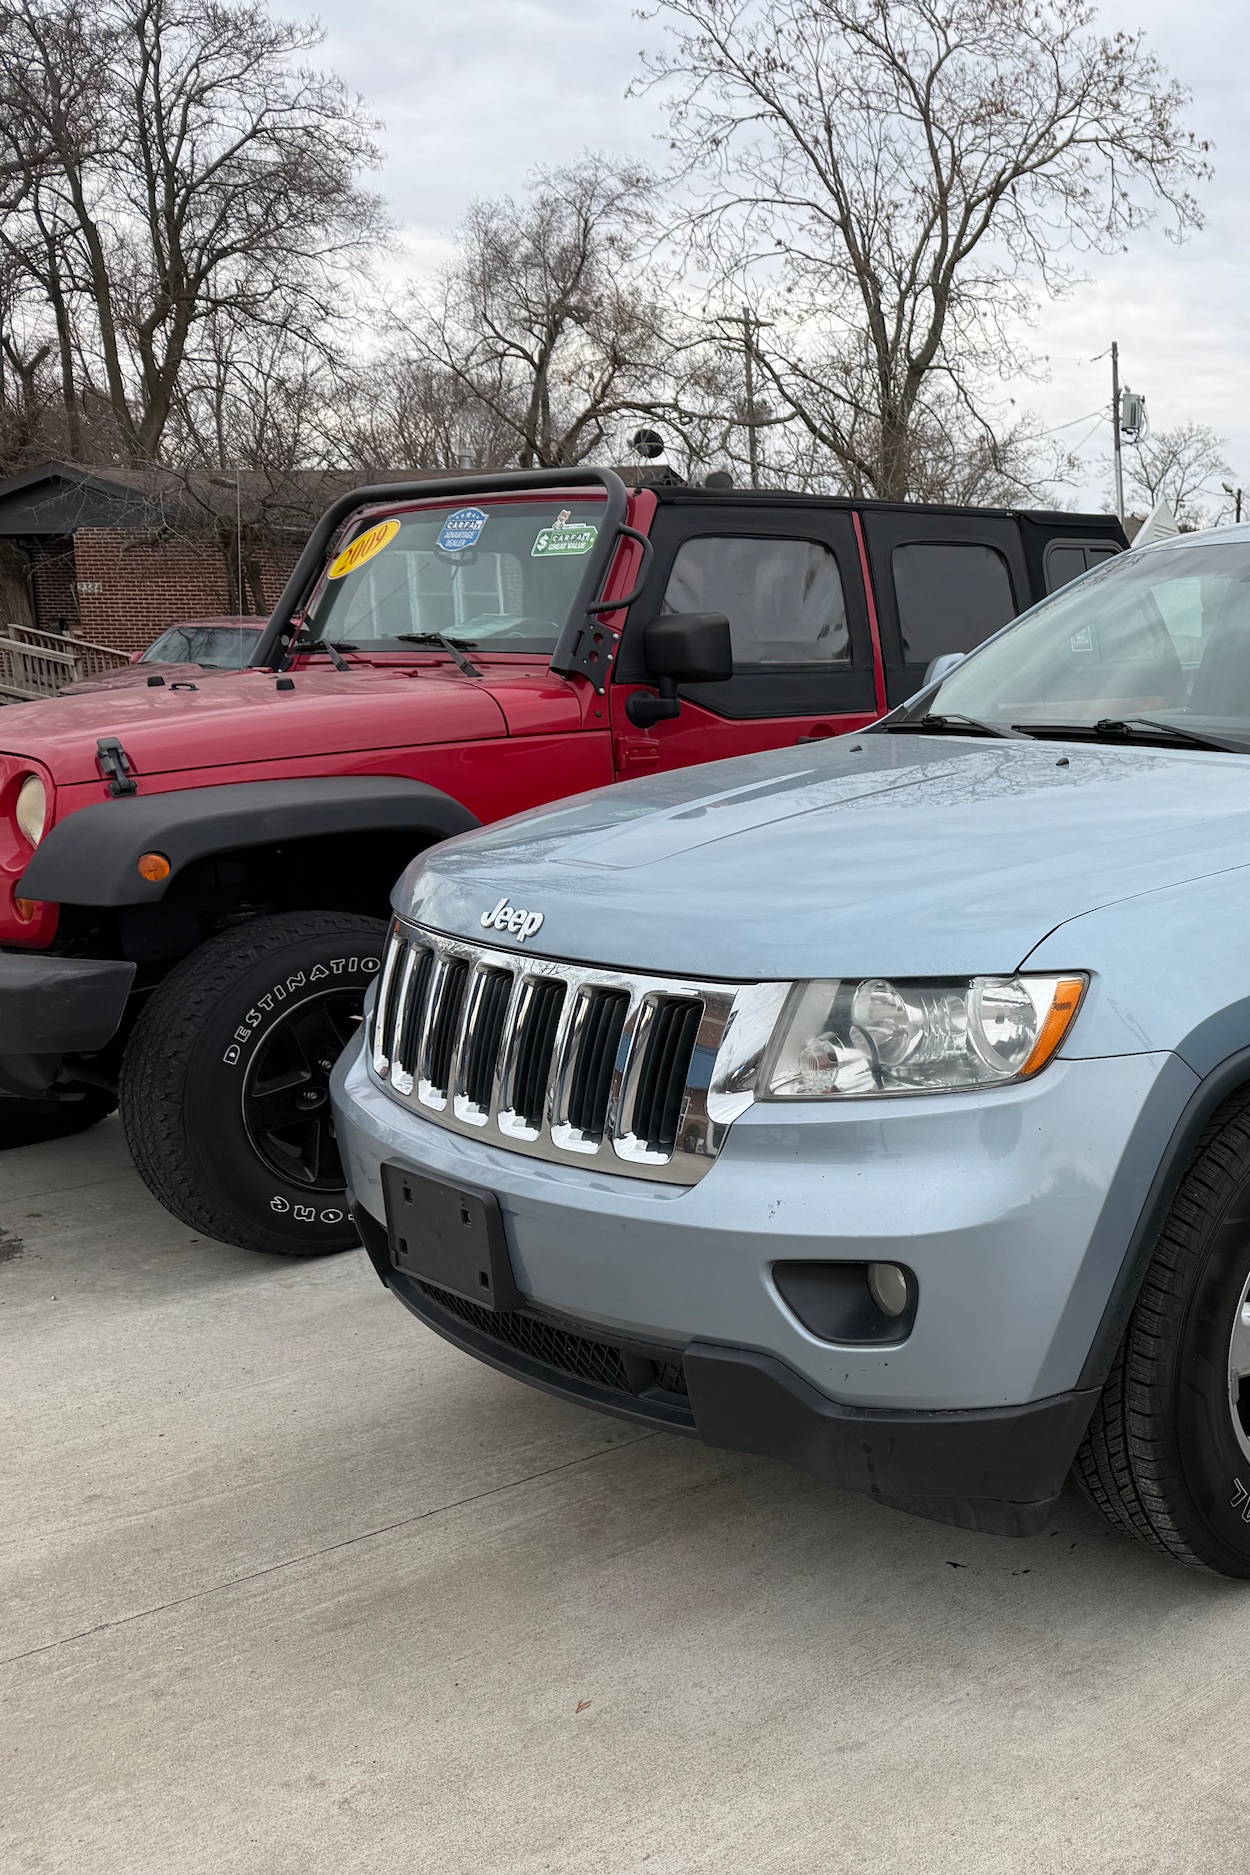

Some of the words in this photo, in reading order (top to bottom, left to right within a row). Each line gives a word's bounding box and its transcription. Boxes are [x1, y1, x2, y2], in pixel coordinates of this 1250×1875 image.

[444, 530, 477, 539] ADVANTAGE
[445, 538, 467, 547] DEALER
[567, 541, 586, 549] VALUE
[336, 524, 389, 573] 2009
[480, 898, 544, 943] Jeep
[223, 957, 381, 1066] DESTINATIO
